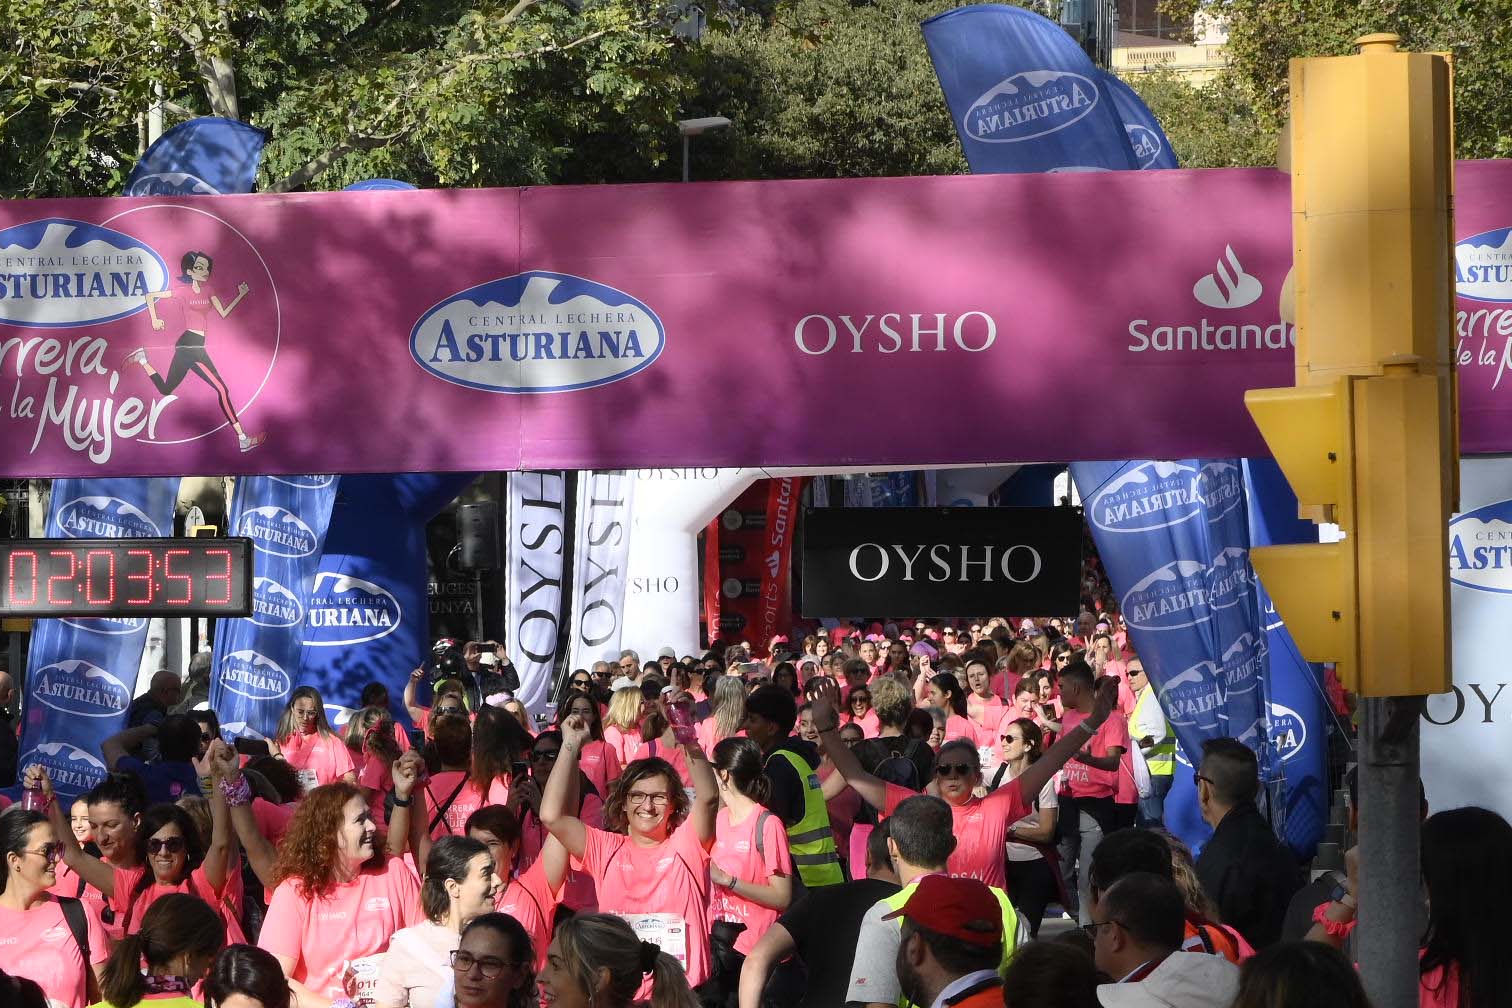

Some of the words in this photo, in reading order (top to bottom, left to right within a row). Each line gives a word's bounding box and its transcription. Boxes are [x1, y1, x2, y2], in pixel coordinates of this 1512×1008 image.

[72, 254, 144, 267] LECHERA
[468, 313, 548, 328] CENTRAL
[556, 311, 637, 326] LECHERA
[794, 310, 998, 356] OYSHO
[1127, 318, 1296, 352] Santand
[1457, 308, 1512, 338] arre
[429, 318, 645, 364] ASTURIANA
[1478, 338, 1496, 366] la
[10, 380, 35, 419] la
[29, 370, 178, 464] Mujer
[239, 517, 310, 552] ASTURIANA
[518, 471, 563, 664] OYSH
[581, 470, 627, 648] OYSH
[848, 542, 1042, 584] OYSHO
[7, 549, 233, 606] 02:03:53
[254, 599, 297, 621] URIANA
[338, 597, 388, 605] LECHERA
[37, 674, 123, 710] ASTURIANA
